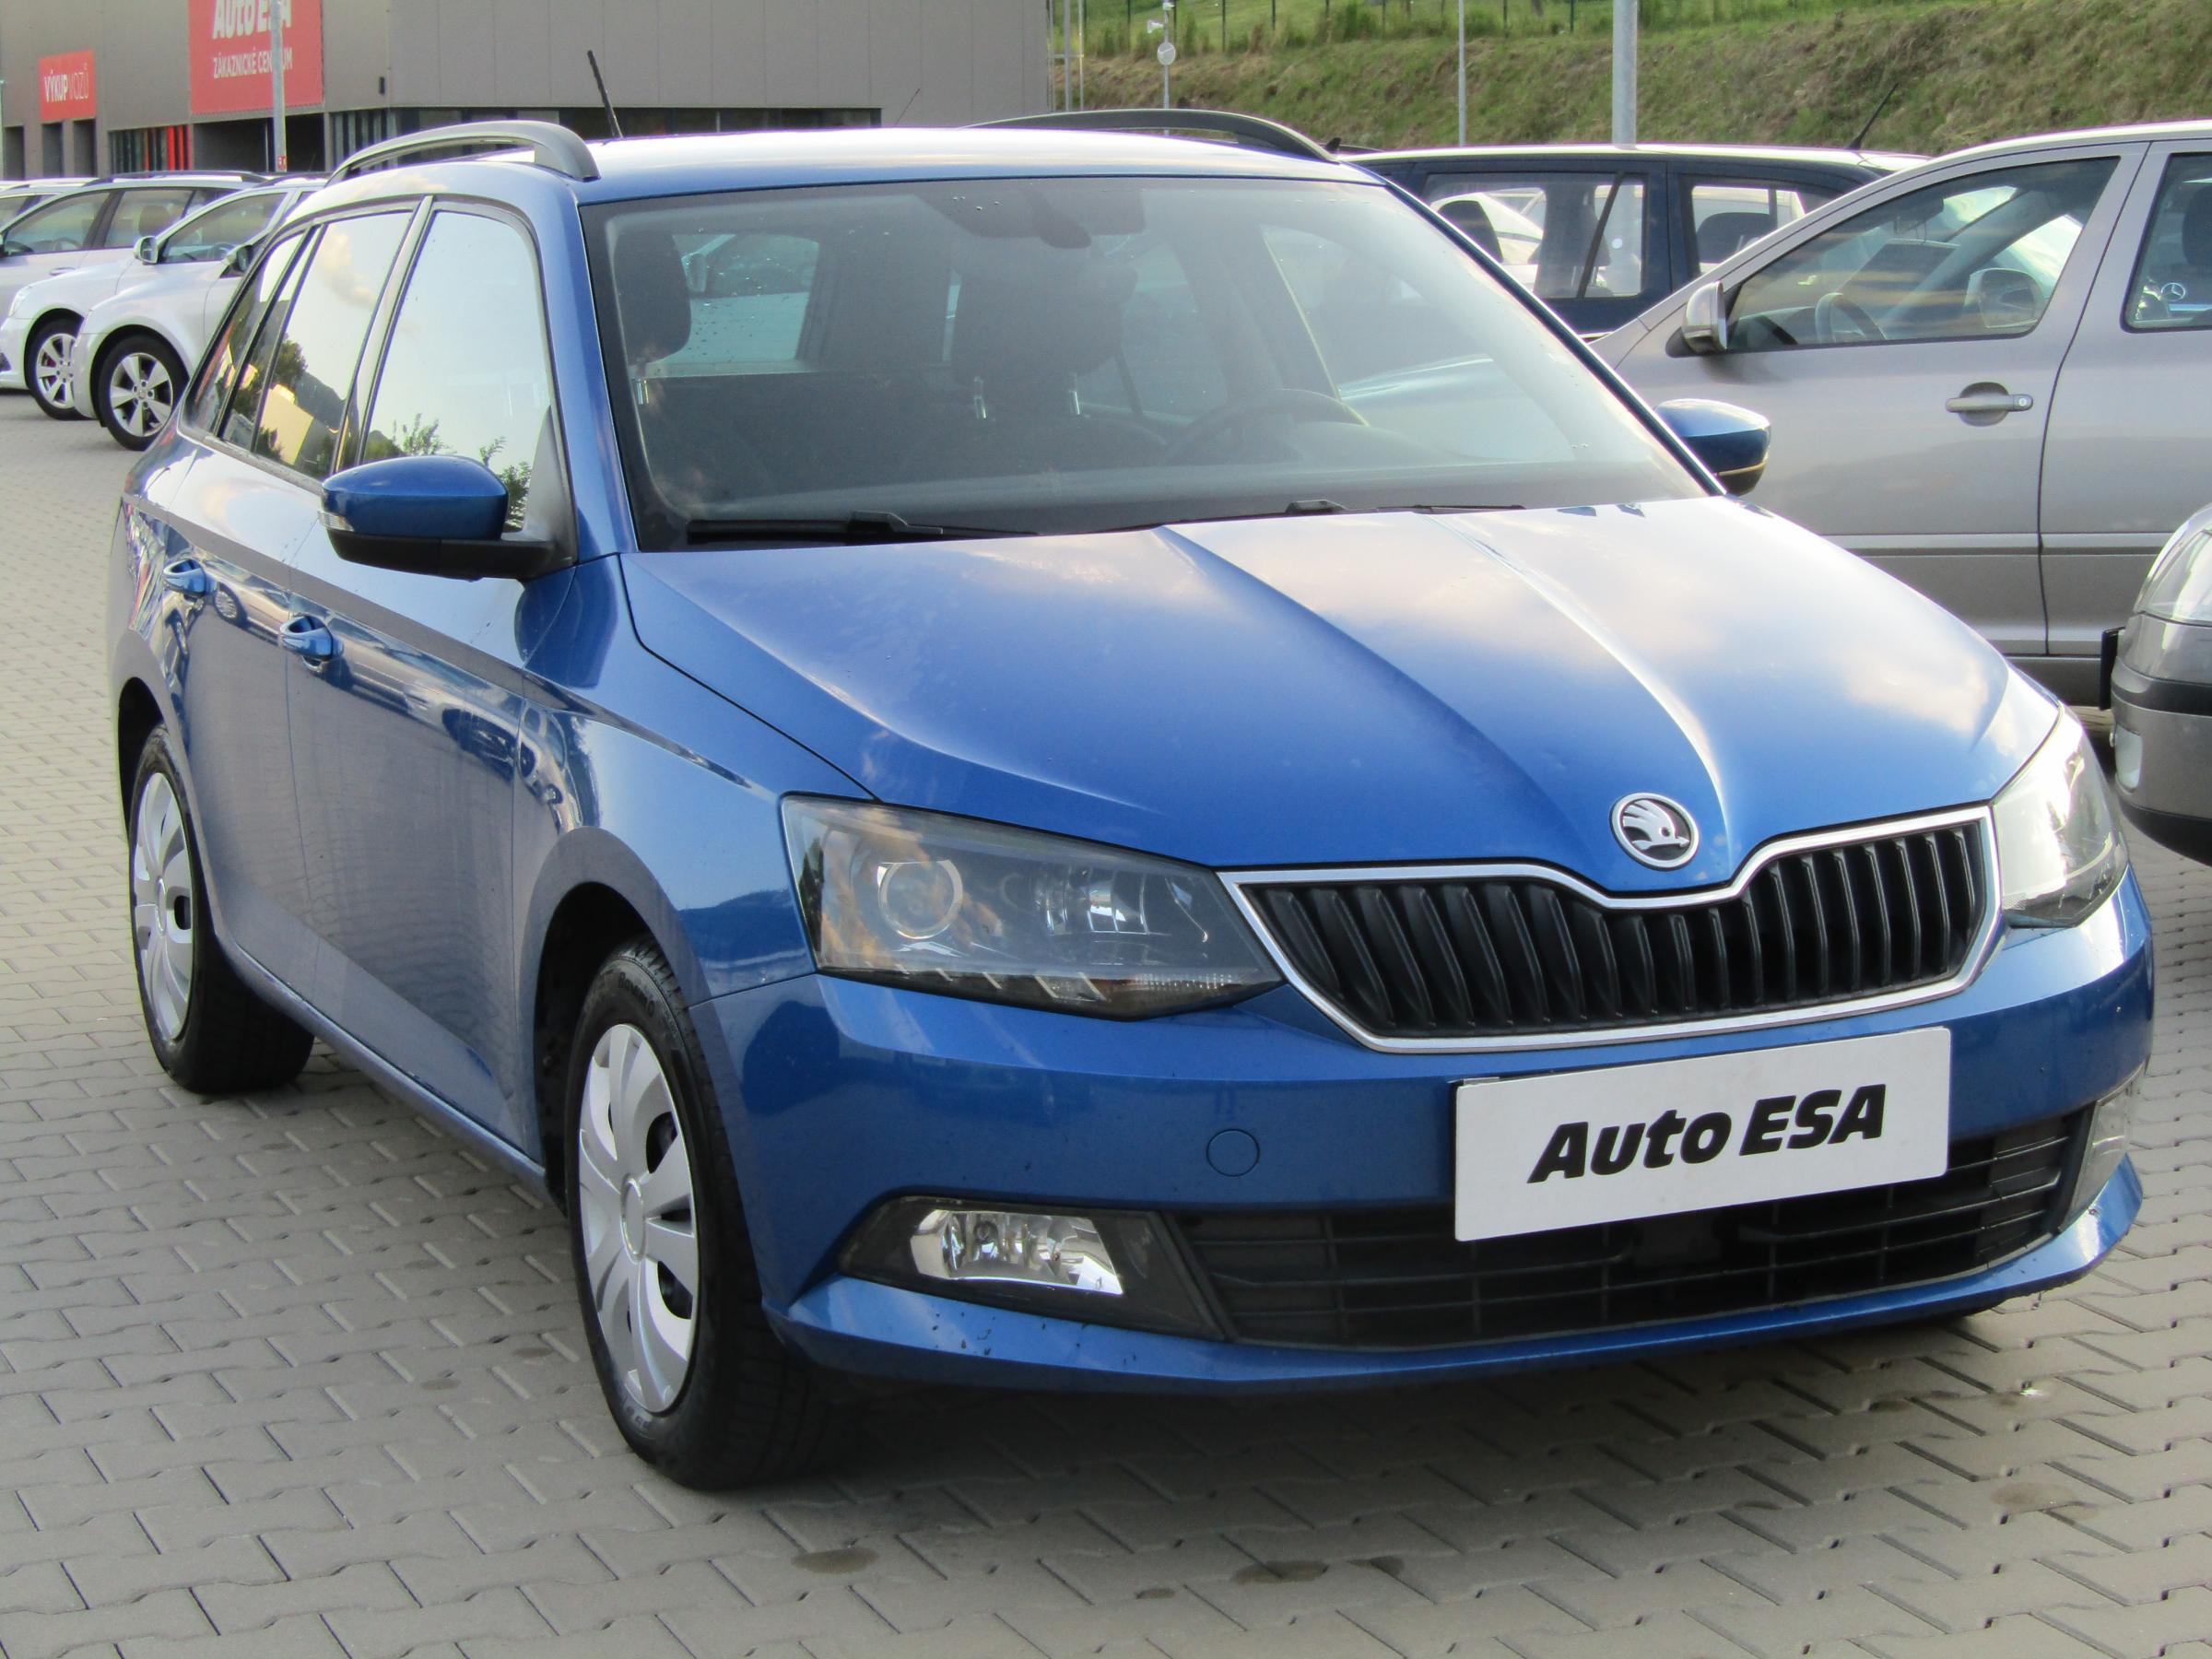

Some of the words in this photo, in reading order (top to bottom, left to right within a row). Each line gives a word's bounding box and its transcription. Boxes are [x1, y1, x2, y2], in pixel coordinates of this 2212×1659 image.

[213, 46, 257, 78] ZÁKAZNICKÉ
[257, 47, 293, 74] CENUM
[44, 69, 68, 102] VÝKUP
[1527, 1109, 1732, 1184] Auto
[1738, 1083, 1887, 1157] ESA
